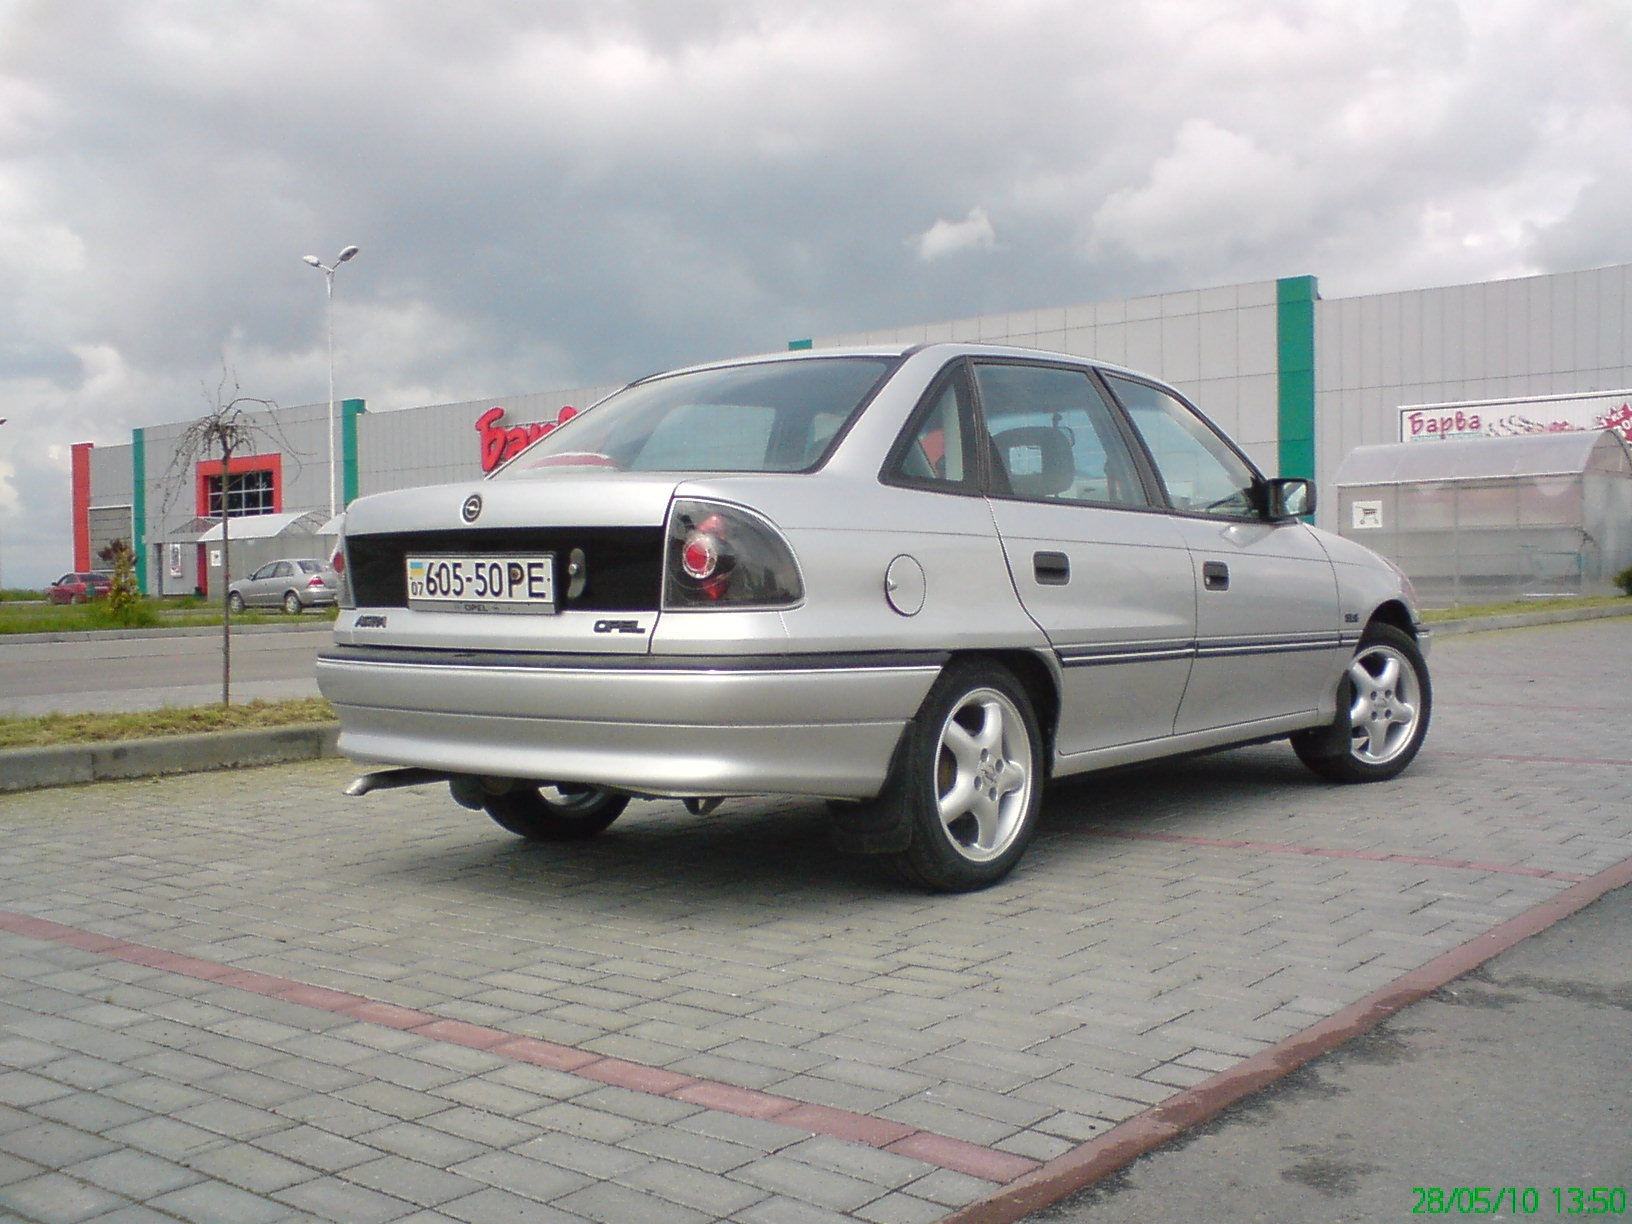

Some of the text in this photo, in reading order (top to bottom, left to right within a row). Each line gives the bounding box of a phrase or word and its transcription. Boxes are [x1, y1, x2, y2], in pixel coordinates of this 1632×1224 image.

[1408, 410, 1481, 439] Барва
[411, 581, 423, 596] 07
[465, 603, 488, 612] OPEL
[593, 619, 646, 634] OPEL
